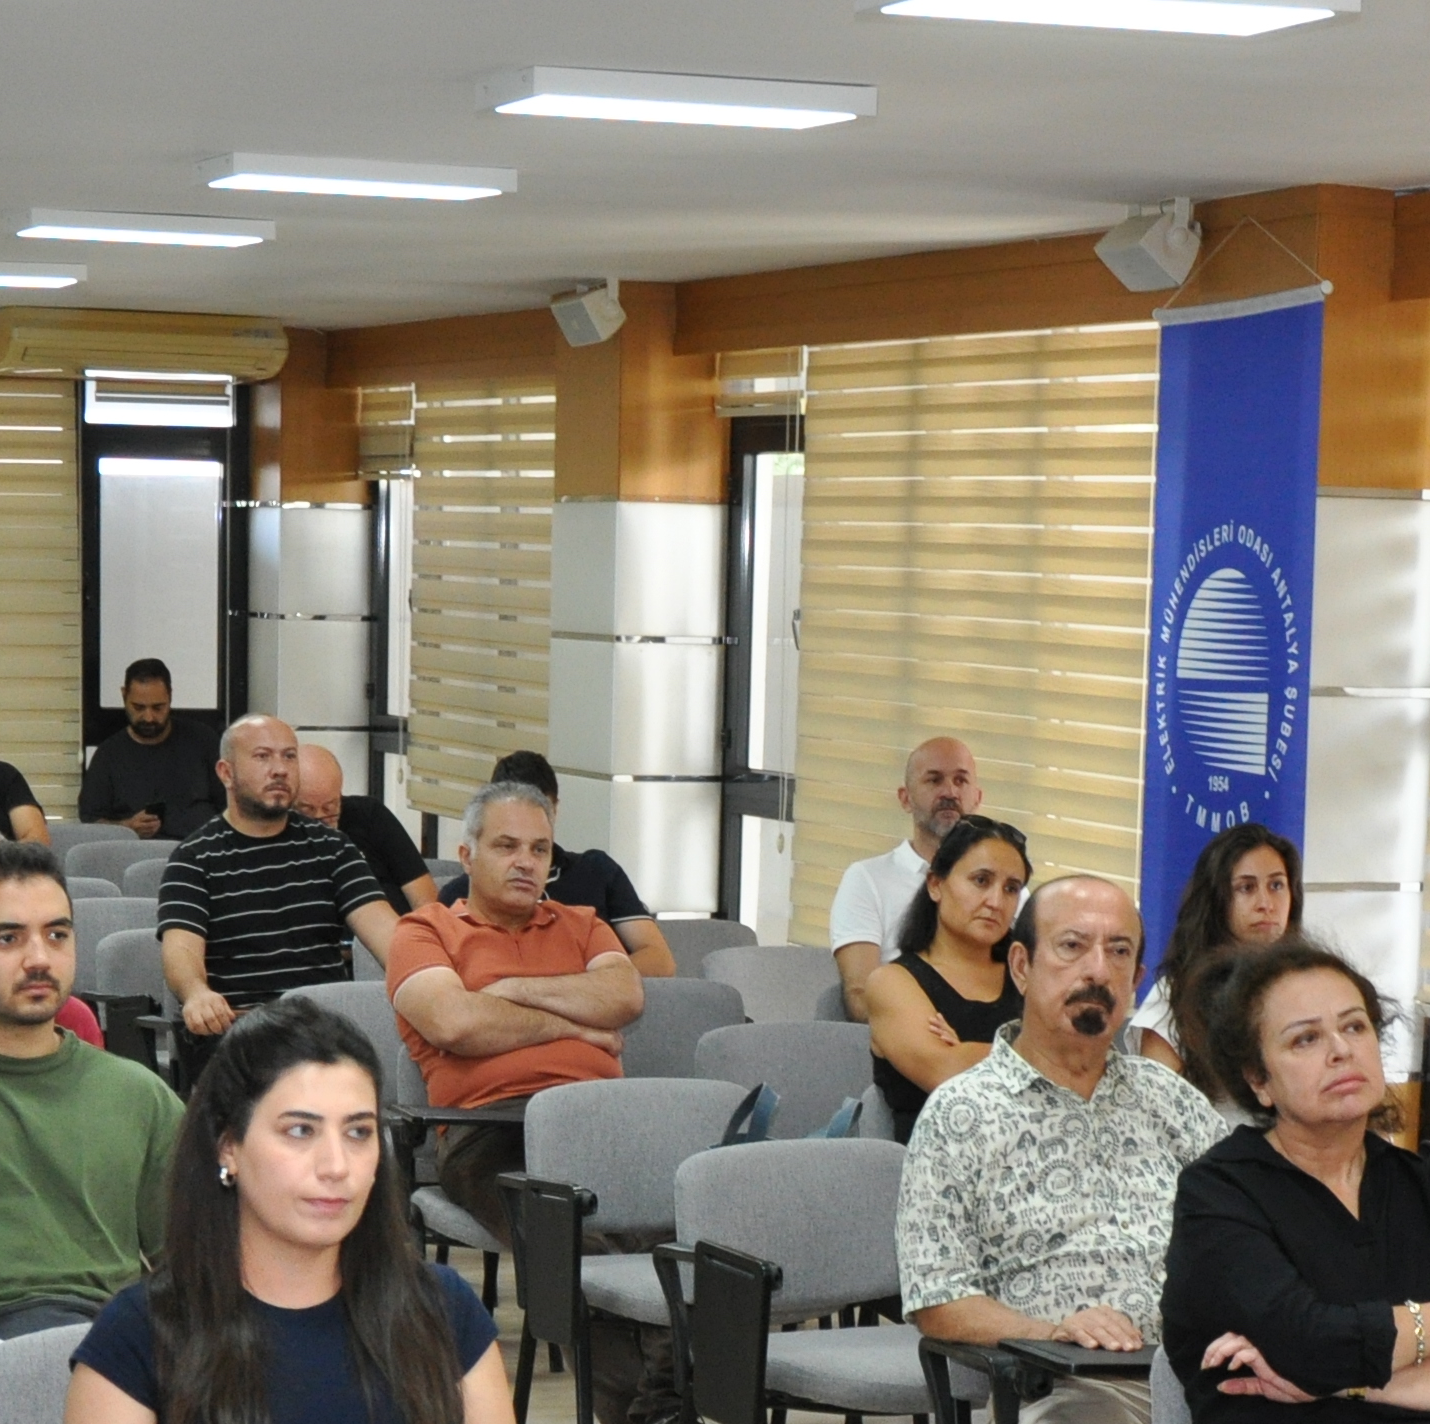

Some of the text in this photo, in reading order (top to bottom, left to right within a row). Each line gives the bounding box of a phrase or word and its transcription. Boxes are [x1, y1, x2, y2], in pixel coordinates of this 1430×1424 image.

[1155, 654, 1175, 776] ELEKTRİK
[1237, 524, 1274, 569] ODASI
[1270, 567, 1300, 675] ANTALYA
[1207, 775, 1230, 793] 1954
[1184, 793, 1251, 834] TMMOB
